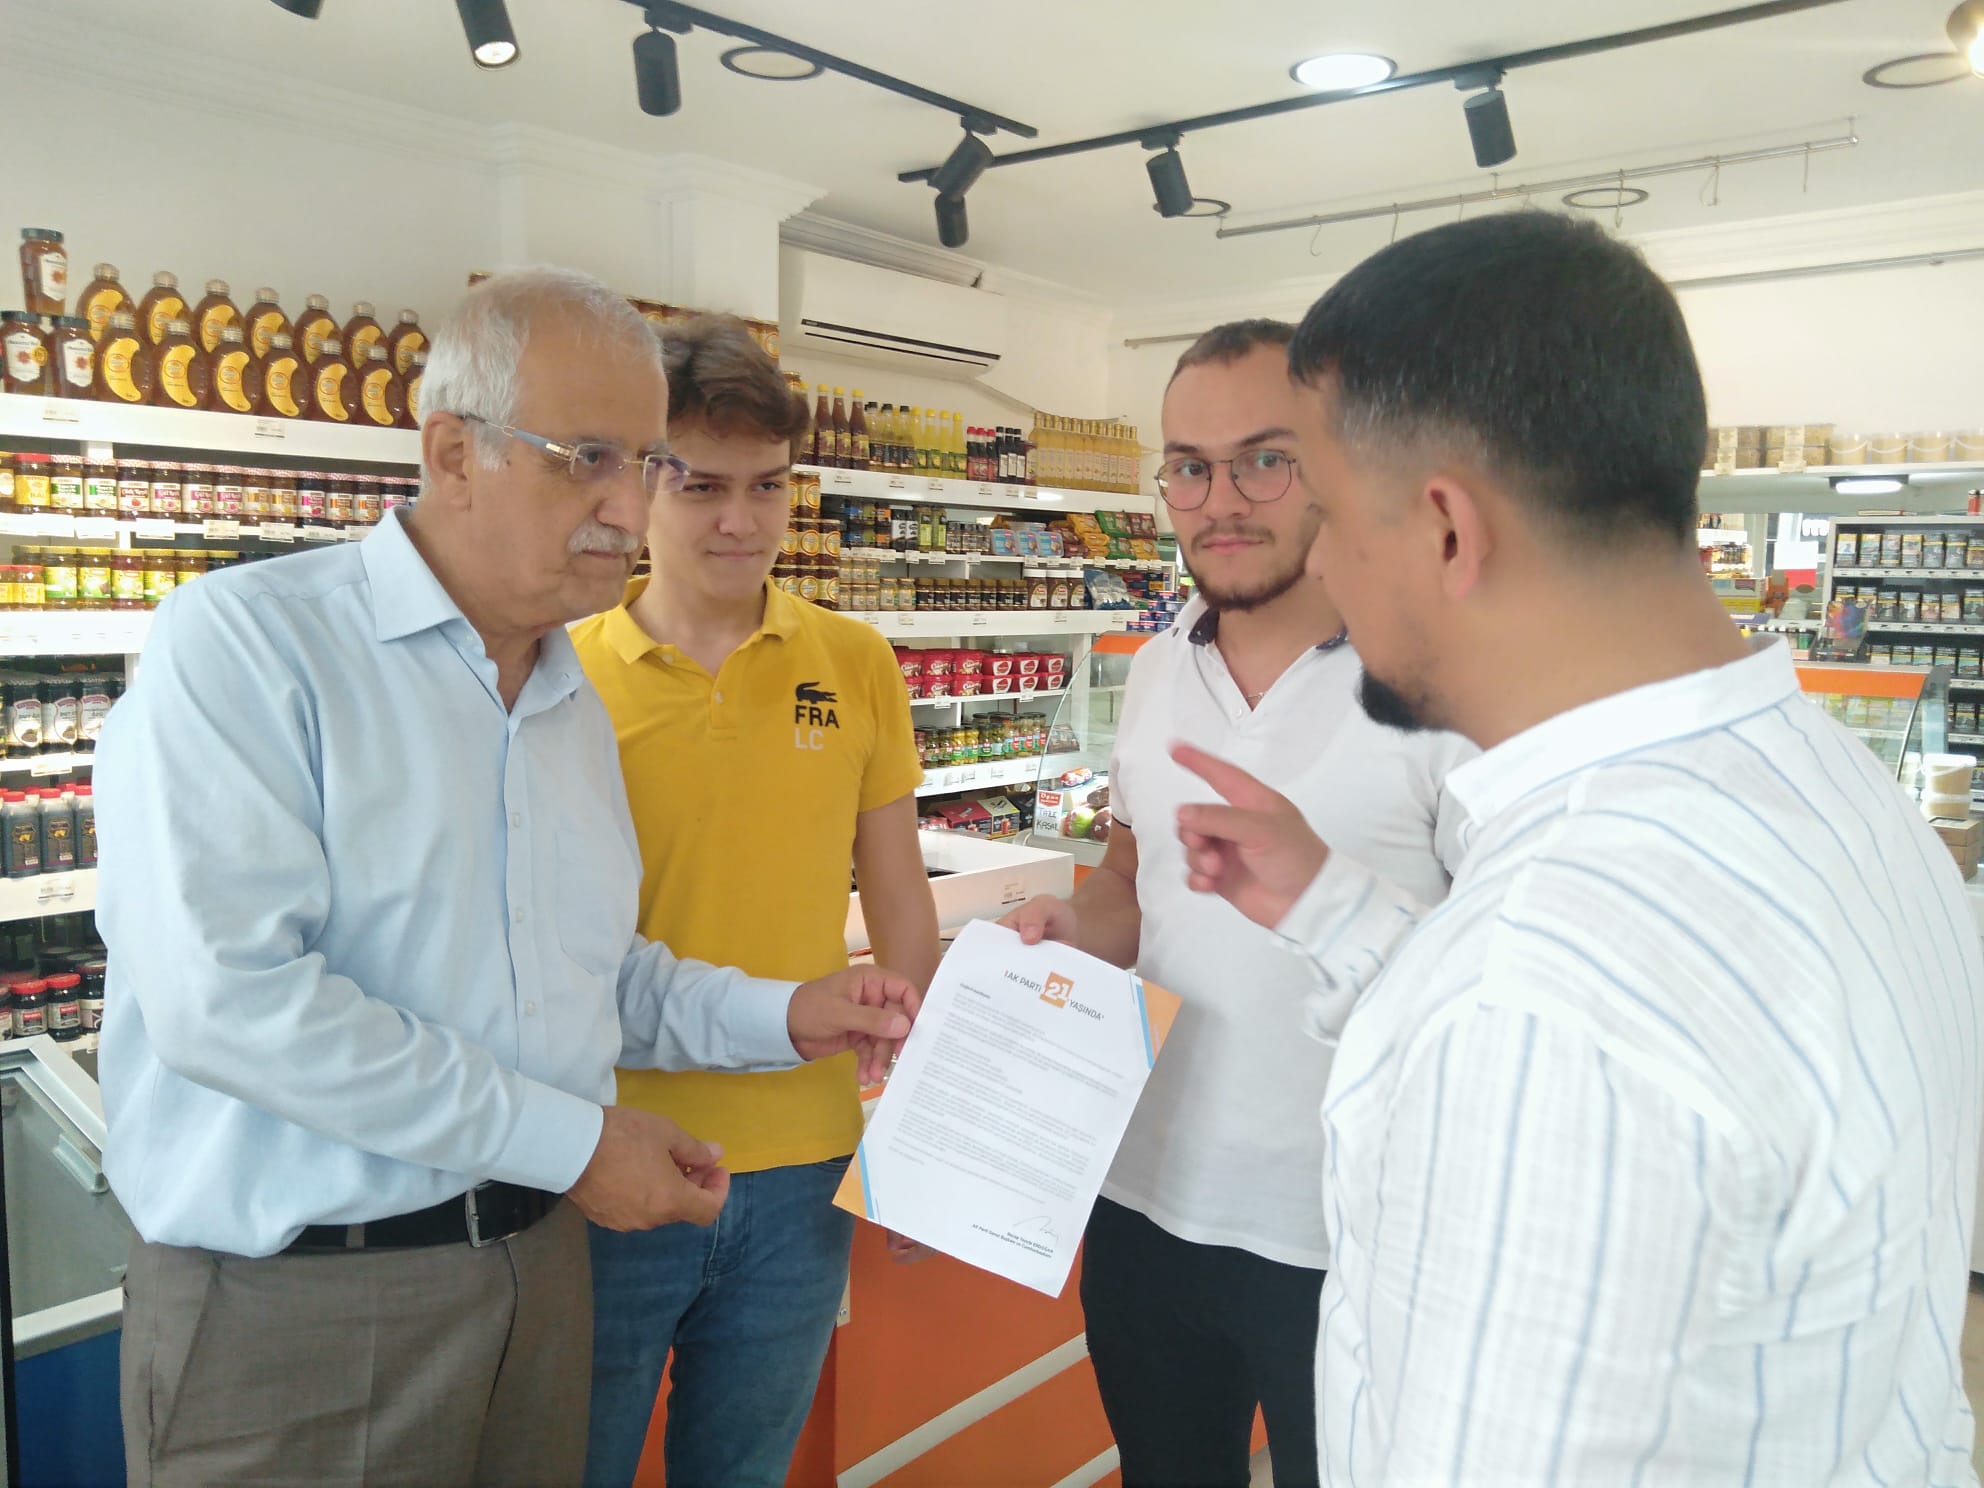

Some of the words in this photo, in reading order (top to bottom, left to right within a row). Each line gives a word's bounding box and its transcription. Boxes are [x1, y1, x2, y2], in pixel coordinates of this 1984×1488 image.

[795, 704, 840, 729] FRA
[794, 728, 824, 751] LC
[1044, 982, 1070, 1001] 21
